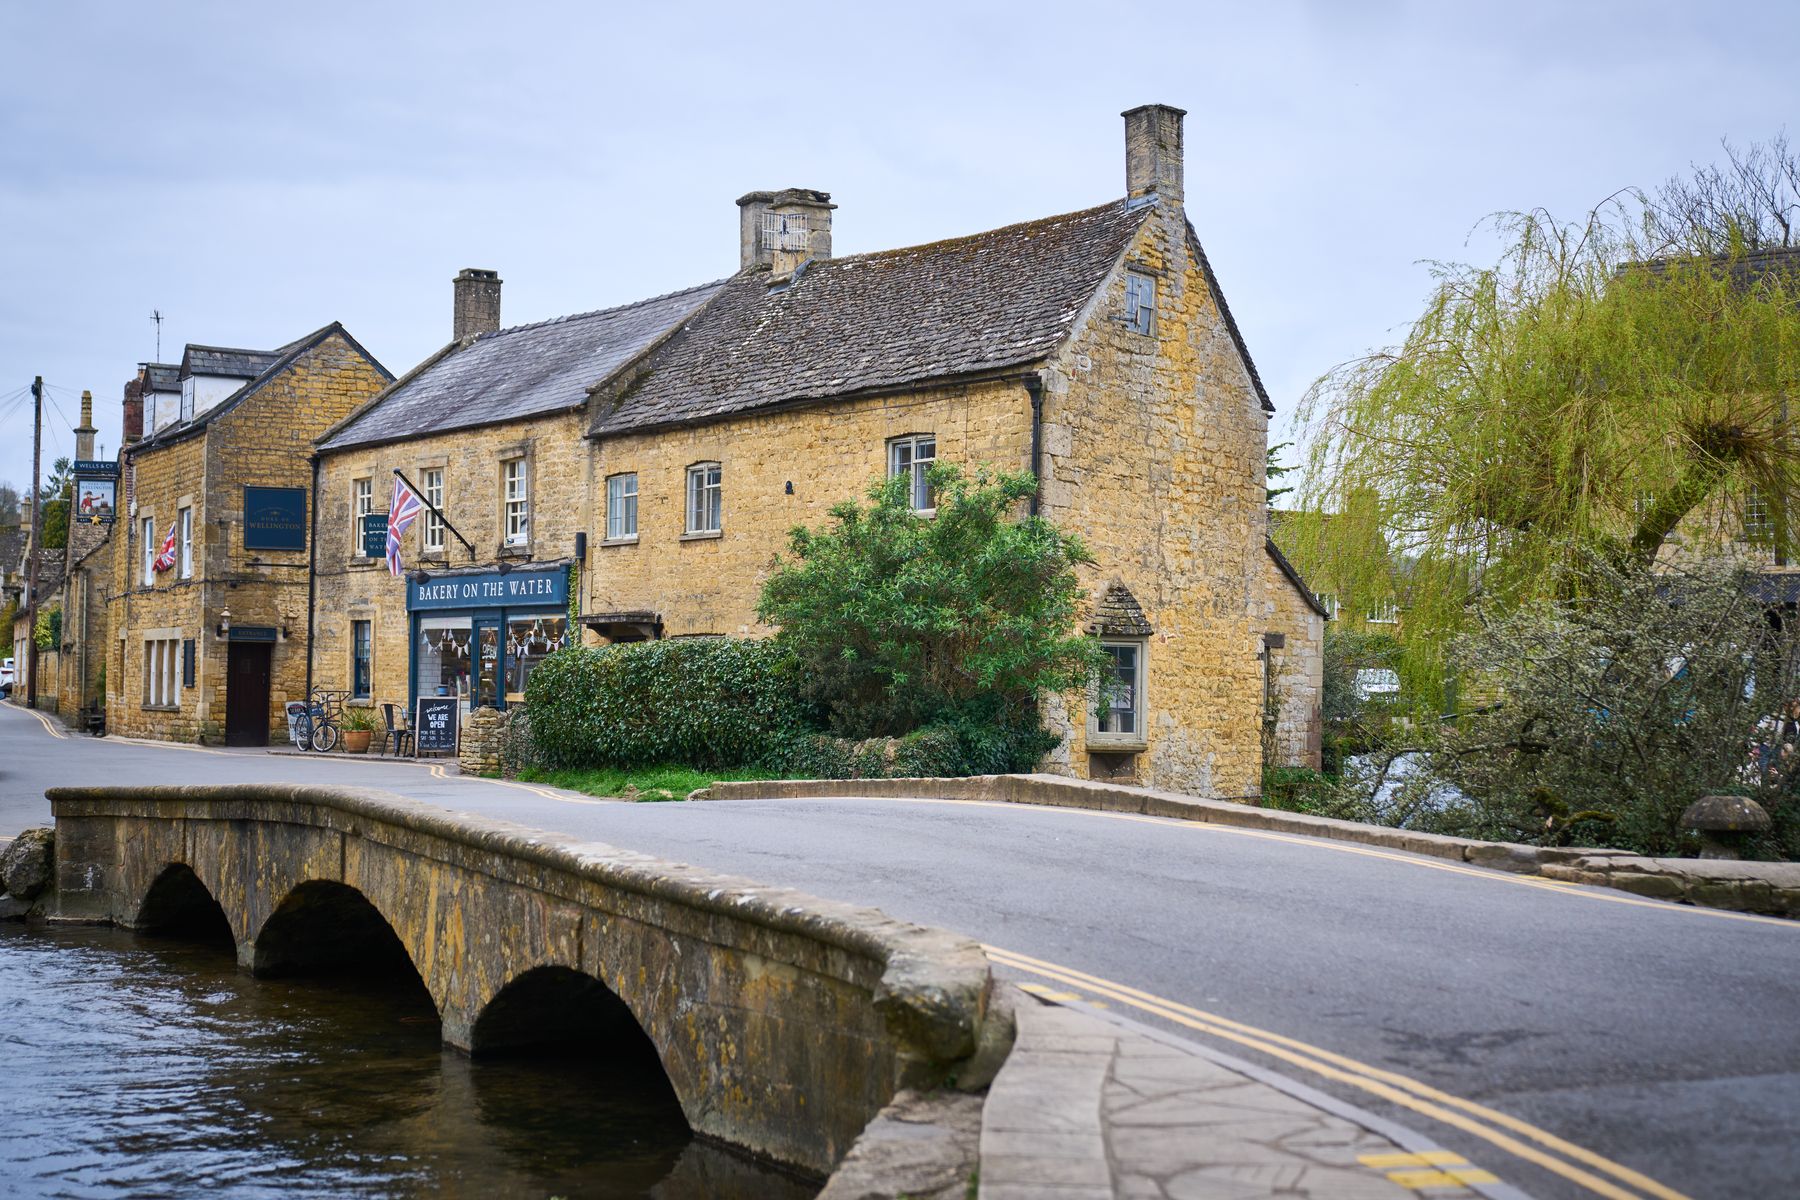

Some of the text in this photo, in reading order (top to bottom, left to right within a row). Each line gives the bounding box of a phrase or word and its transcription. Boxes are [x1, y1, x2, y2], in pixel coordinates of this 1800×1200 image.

[419, 578, 552, 600] BAKERY ON THE WATER
[482, 644, 498, 657] OPEN
[430, 720, 445, 728] OPEN
